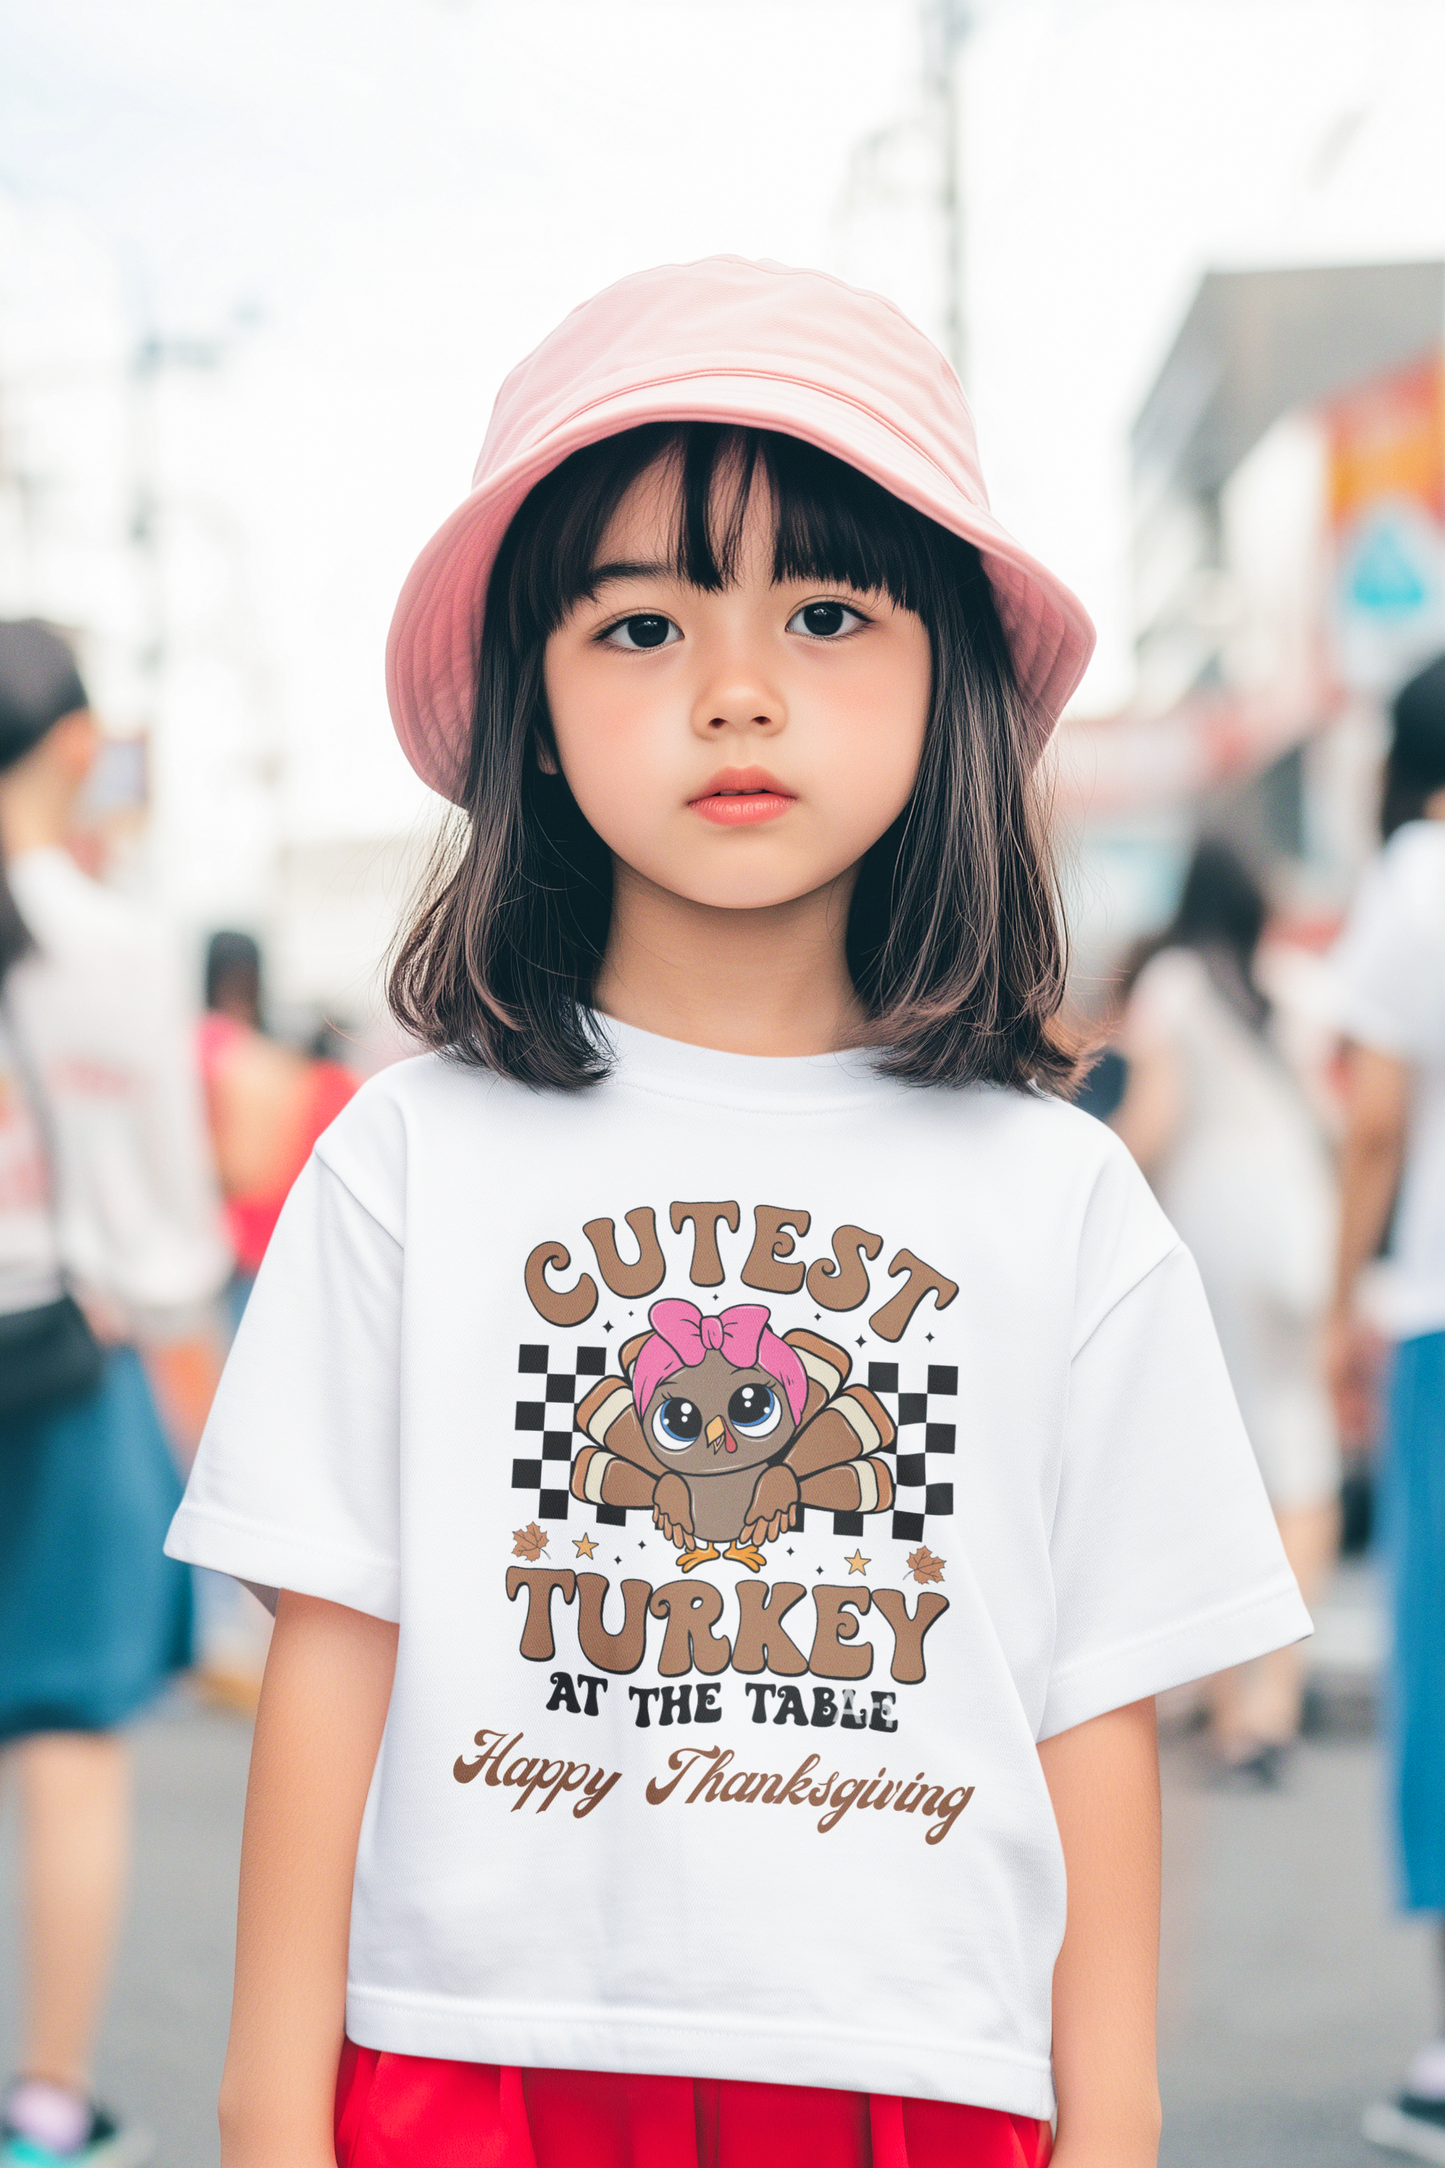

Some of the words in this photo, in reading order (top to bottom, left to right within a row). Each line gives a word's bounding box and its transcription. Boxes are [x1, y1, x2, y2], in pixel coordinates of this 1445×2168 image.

[524, 1200, 959, 1343] CUTEST
[505, 1566, 950, 1685] TURKEY
[546, 1672, 608, 1716] AT
[628, 1682, 722, 1728] THE
[745, 1682, 898, 1733] TABLE
[453, 1729, 622, 1819] Happy
[646, 1745, 975, 1845] Thanksgiving
